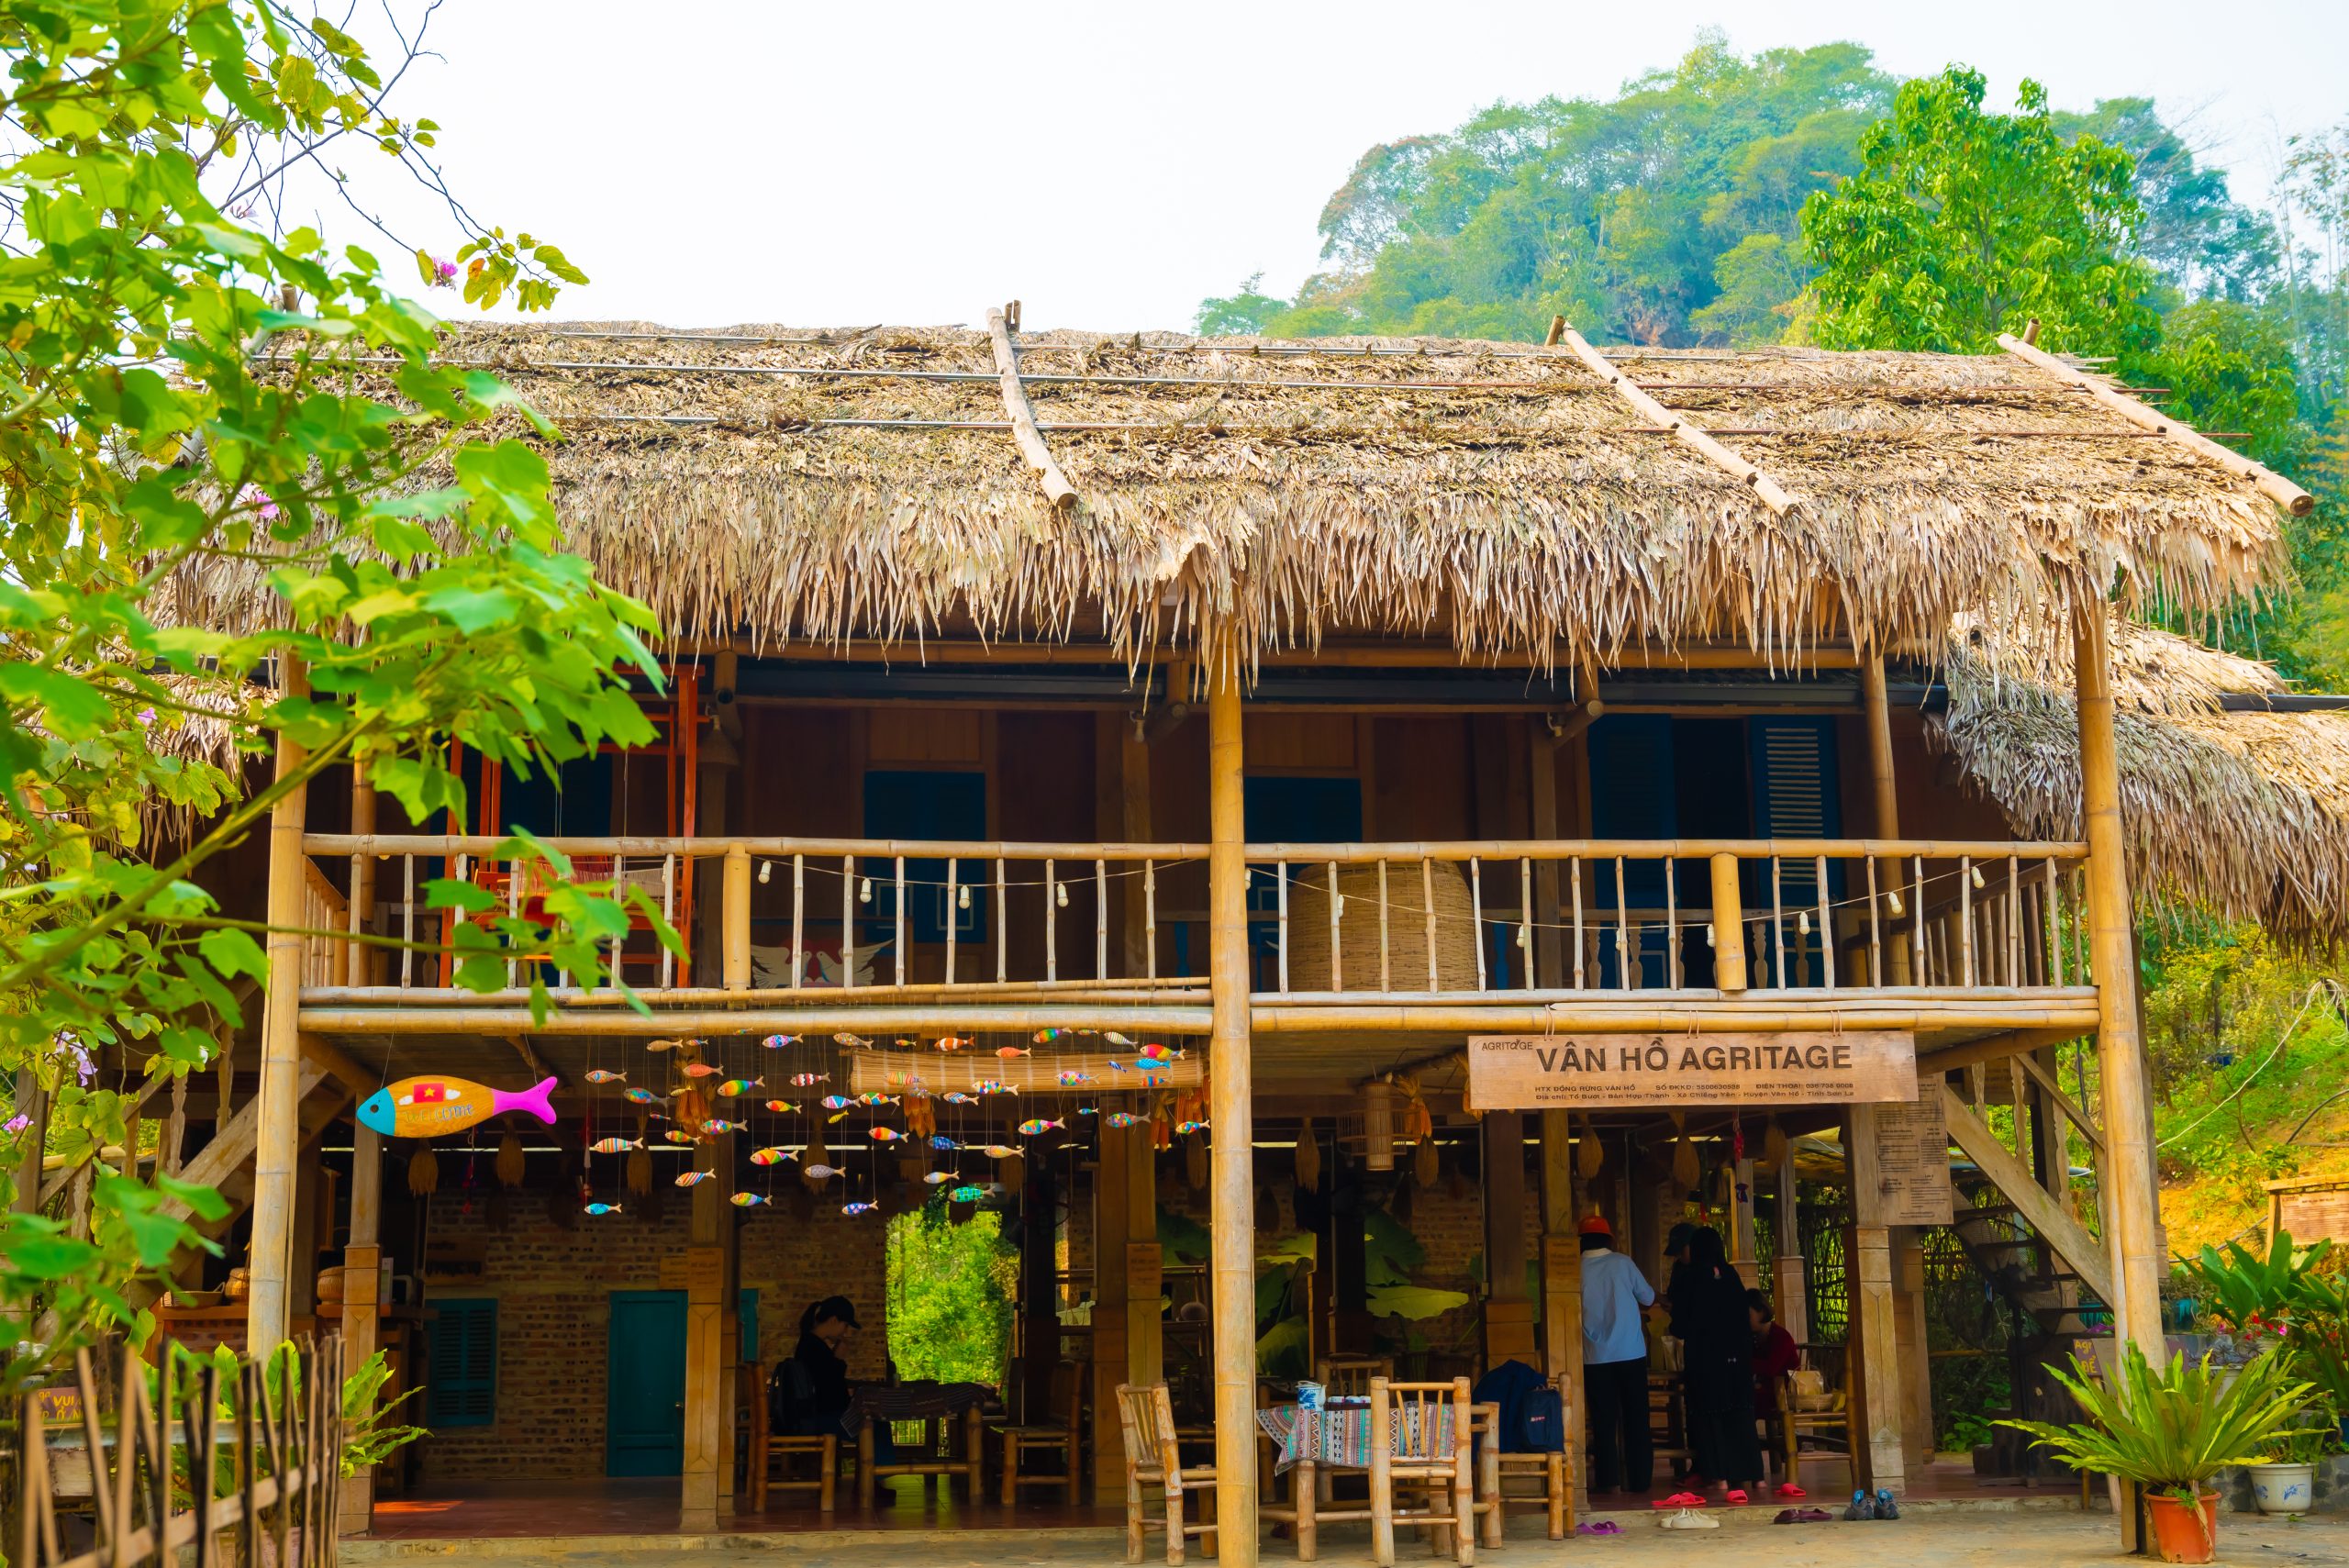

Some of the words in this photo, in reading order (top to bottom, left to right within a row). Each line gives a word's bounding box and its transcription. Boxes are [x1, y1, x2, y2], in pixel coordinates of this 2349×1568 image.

[1536, 1041, 1606, 1072] VÂN
[1620, 1037, 1669, 1071] HỒ
[1678, 1045, 1853, 1071] AGRITAGE
